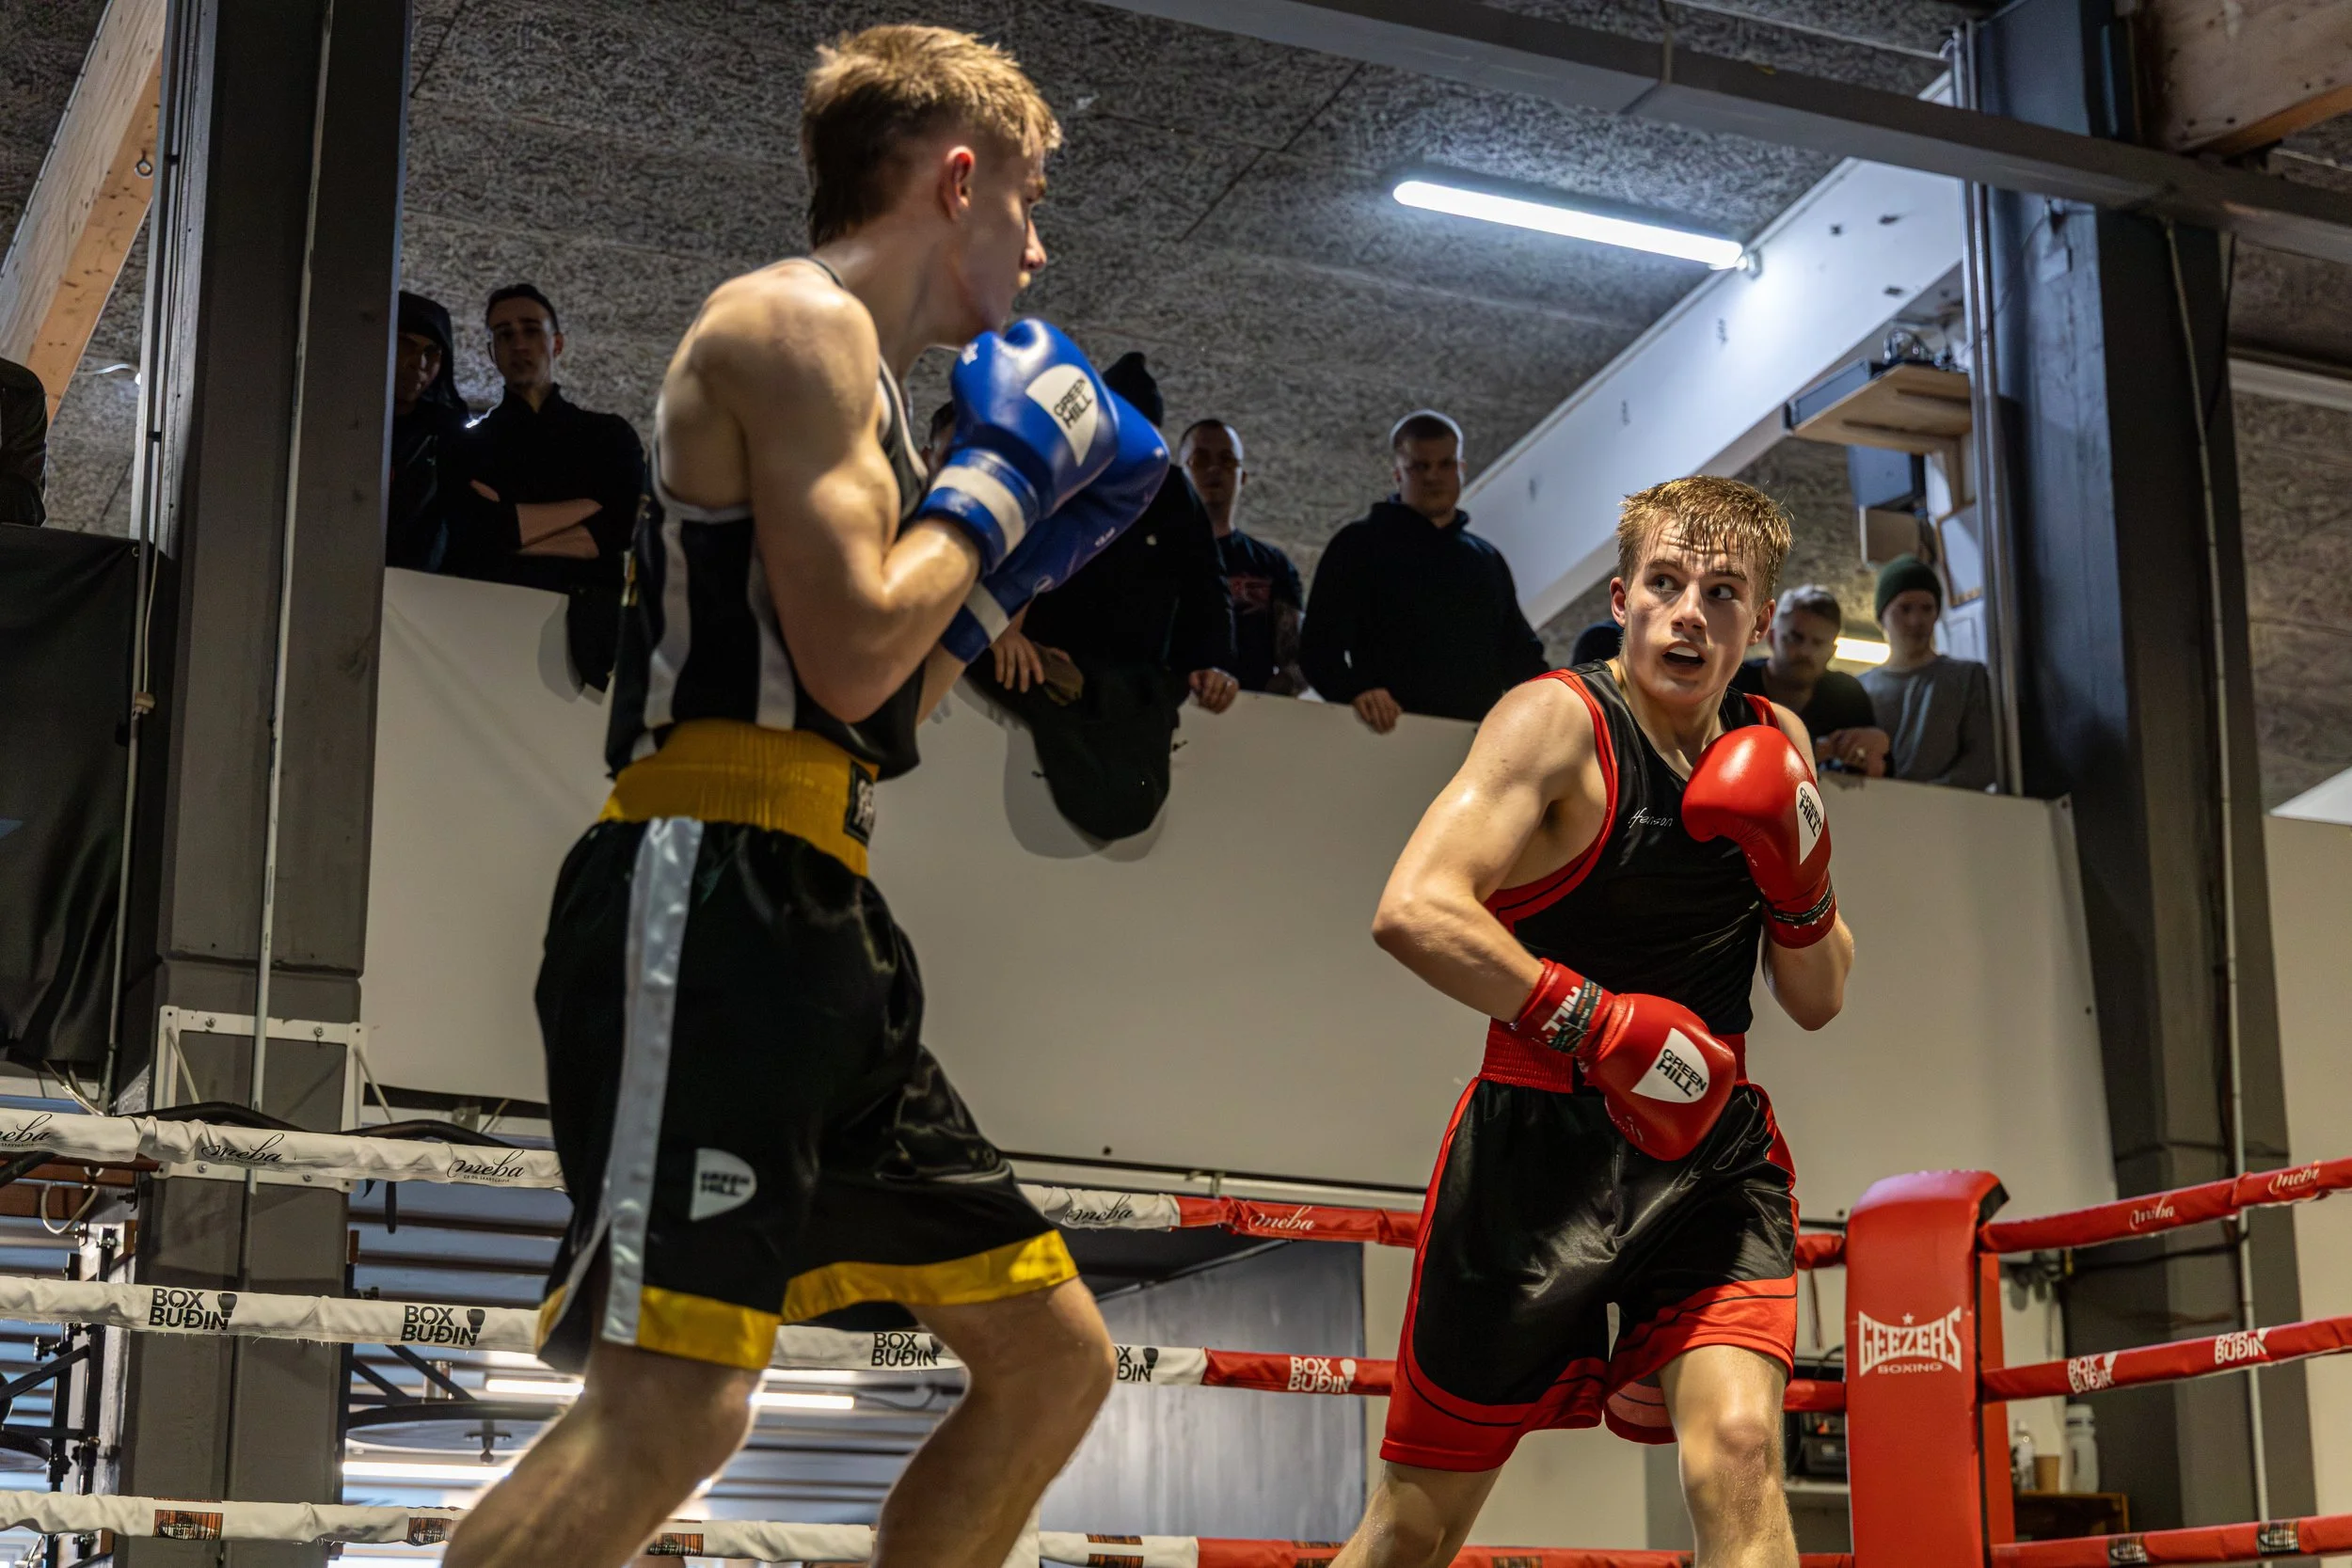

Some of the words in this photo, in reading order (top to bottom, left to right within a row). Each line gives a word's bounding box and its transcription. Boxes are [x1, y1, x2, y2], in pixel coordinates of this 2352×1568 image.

[1054, 378, 1086, 417] GREEN
[1062, 394, 1093, 429] HILL
[1799, 798, 1817, 837] HILL
[1800, 786, 1822, 830] GREEN
[1656, 1058, 1692, 1098] HILL
[1662, 1048, 1708, 1091] GREEN
[0, 1114, 53, 1143] eba
[700, 1184, 742, 1198] HILL
[151, 1288, 205, 1310] BOX
[404, 1306, 454, 1326] BOX
[873, 1332, 918, 1351] BOX
[1858, 1306, 1963, 1378] GEEZERS
[1290, 1356, 1333, 1376] BOX
[1877, 1362, 1944, 1375] BOXING
